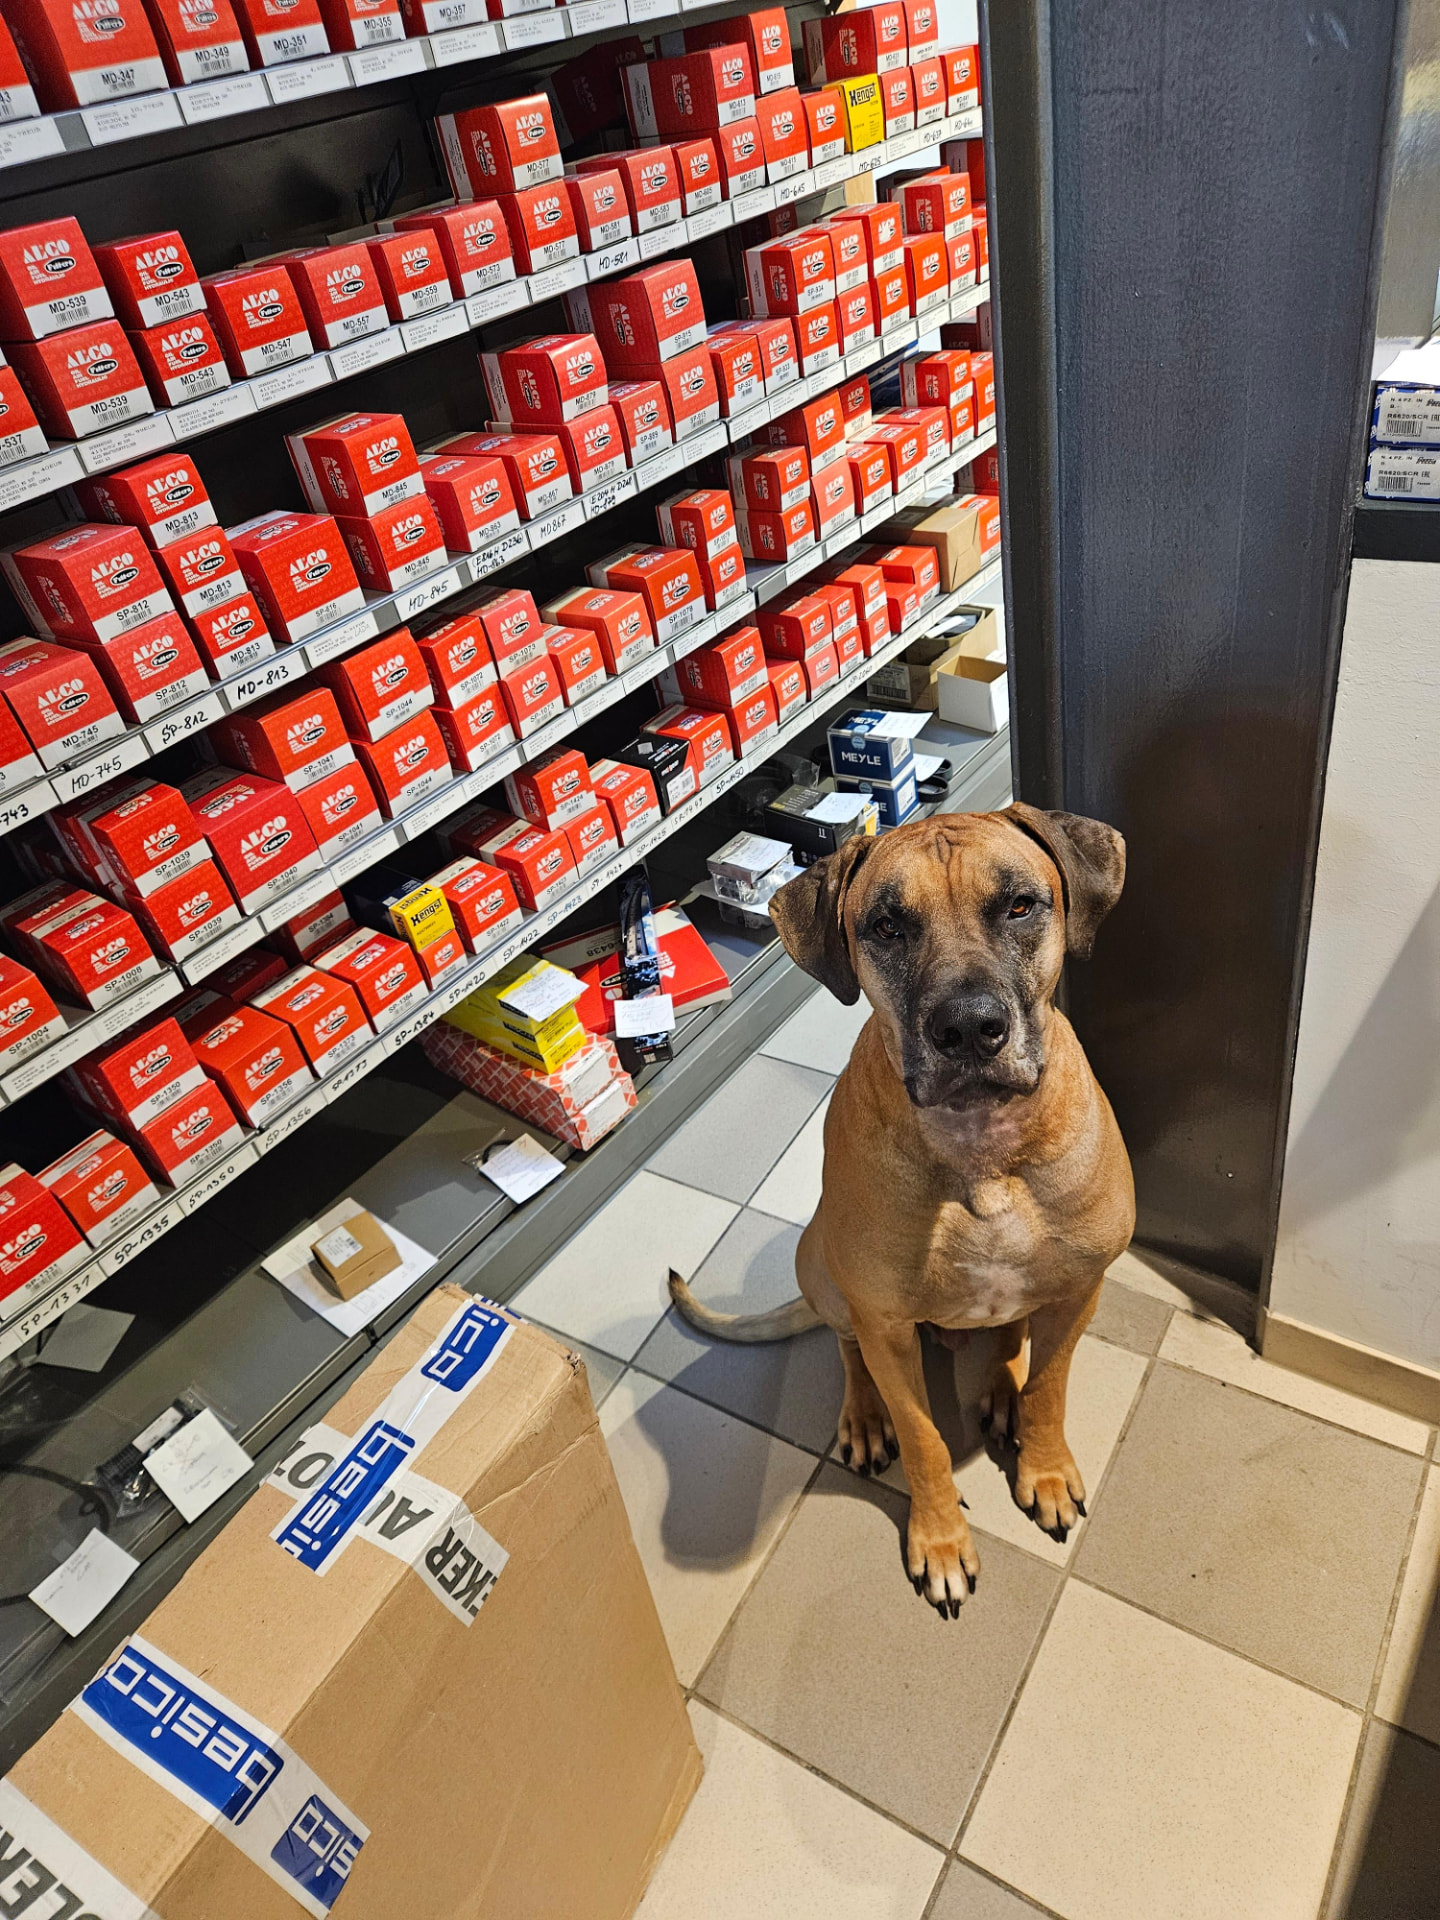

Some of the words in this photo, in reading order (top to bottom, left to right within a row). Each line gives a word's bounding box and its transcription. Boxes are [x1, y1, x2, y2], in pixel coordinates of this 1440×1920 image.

[439, 5, 466, 19] MD-357
[363, 17, 392, 30] MD-355
[273, 35, 308, 51] MD-351
[195, 47, 229, 63] MD-349
[101, 69, 135, 85] MD-347
[849, 82, 876, 107] Hengst
[516, 113, 544, 130] ALCO
[771, 110, 793, 127] ALCO
[526, 159, 549, 173] MD-577
[649, 204, 670, 217] MD-583
[463, 219, 494, 239] ALCO
[600, 221, 620, 235] MD-581
[23, 239, 70, 264] ALCO
[136, 245, 178, 271] ALCO
[543, 241, 565, 255] MD-577
[46, 258, 74, 272] Filters
[156, 264, 182, 277] Filters
[476, 264, 501, 279] MD-573
[599, 251, 629, 272] MD-581
[326, 265, 361, 286] ALCO
[154, 289, 190, 306] MD-543
[242, 289, 279, 311] ALCO
[411, 286, 438, 300] MD-559
[662, 282, 688, 303] ALCO
[49, 296, 87, 315] MD-539
[343, 316, 369, 331] MD-557
[161, 327, 203, 352] ALCO
[261, 338, 291, 356] MD-547
[67, 343, 113, 369] ALCO
[566, 351, 592, 369] ALCO
[89, 360, 117, 375] Filters
[180, 368, 215, 386] MD-543
[90, 396, 128, 415] MD-539
[575, 392, 596, 405] MD-879
[365, 436, 398, 459] ALCO
[594, 461, 615, 474] MD-879
[146, 469, 189, 498] ALCO
[167, 485, 193, 501] Filters
[382, 482, 408, 499] MD-845
[165, 511, 199, 532] MD-813
[479, 521, 501, 537] MD-863
[540, 514, 567, 538] MD867
[91, 553, 134, 582] ALCO
[289, 549, 327, 577] ALCO
[404, 556, 430, 573] MD-845
[112, 568, 138, 585] Filters
[661, 572, 689, 595] ALCO
[200, 579, 232, 600] MD-813
[408, 580, 449, 611] MD-845
[116, 600, 150, 621] SP-812
[315, 603, 337, 617] SP-816
[230, 642, 261, 663] MD-813
[508, 643, 536, 663] SP-1073
[155, 680, 187, 700] SP-812
[237, 665, 289, 700] MD-813
[460, 671, 484, 691] SP-1072
[37, 679, 84, 709] ALCO
[59, 693, 89, 711] Filters
[386, 698, 413, 719] SP-1044
[530, 702, 555, 723] SP-1073
[62, 725, 99, 749] MD-745
[161, 710, 209, 744] SP-812
[303, 754, 334, 775] SP-1041
[841, 751, 881, 765] MEYLE
[71, 755, 122, 793] MD-745
[551, 769, 579, 790] ALCO
[406, 776, 432, 797] SP-1044
[143, 823, 176, 850] ALCO
[241, 815, 287, 854] ALCO
[262, 831, 291, 853] Filters
[338, 822, 363, 843] SP-1041
[636, 829, 667, 857] SP-1425
[155, 850, 191, 877] SP-1039
[267, 867, 298, 889] SP-1040
[474, 889, 503, 913] ALCO
[547, 896, 582, 925] SP-1423
[411, 898, 442, 927] Hengst
[189, 917, 222, 942] SP-1039
[486, 918, 510, 937] SP-1422
[90, 937, 126, 964] ALCO
[503, 929, 540, 962] SP-1422
[104, 966, 142, 992] SP-1008
[449, 971, 486, 1004] SP-1420
[8, 1026, 49, 1055] SP-1004
[328, 1034, 356, 1058] SP-1373
[129, 1044, 168, 1076] ALCO
[245, 1047, 281, 1080] ALCO
[150, 1081, 181, 1106] SP-1350
[261, 1079, 293, 1105] SP-1356
[265, 1107, 311, 1149] SP-1356
[190, 1139, 222, 1165] SP-1350
[88, 1170, 124, 1202] ALCO
[189, 1165, 235, 1208] SP-1350
[114, 1214, 169, 1265] SP-1335
[104, 1653, 276, 1826] besico
